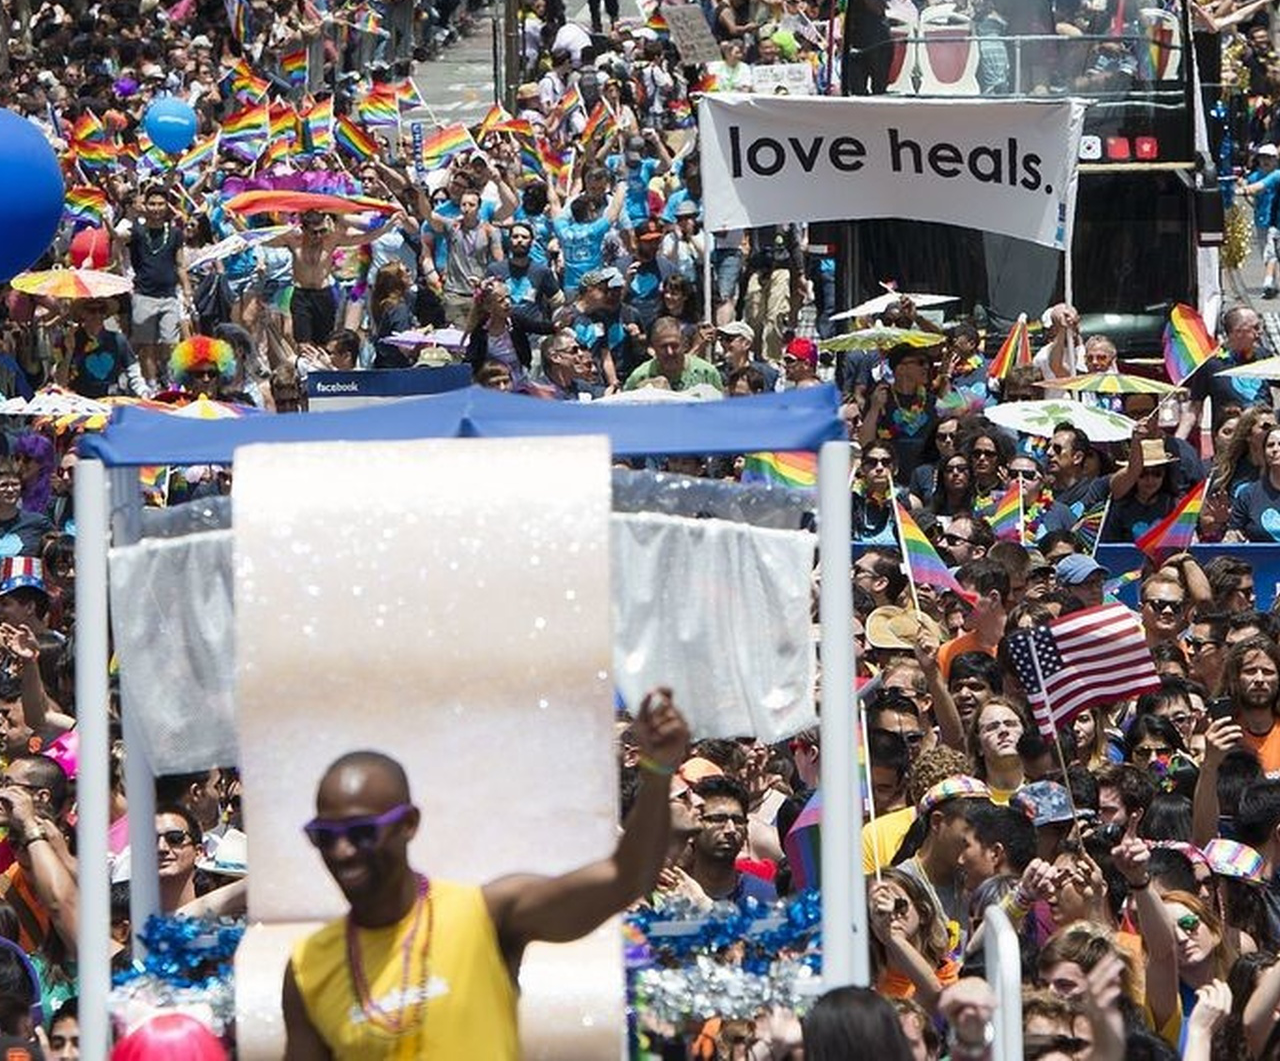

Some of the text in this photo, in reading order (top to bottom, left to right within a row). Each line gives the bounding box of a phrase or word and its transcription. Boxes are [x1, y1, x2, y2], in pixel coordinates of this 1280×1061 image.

[728, 126, 1054, 196] love heals.
[316, 382, 359, 393] facebook
